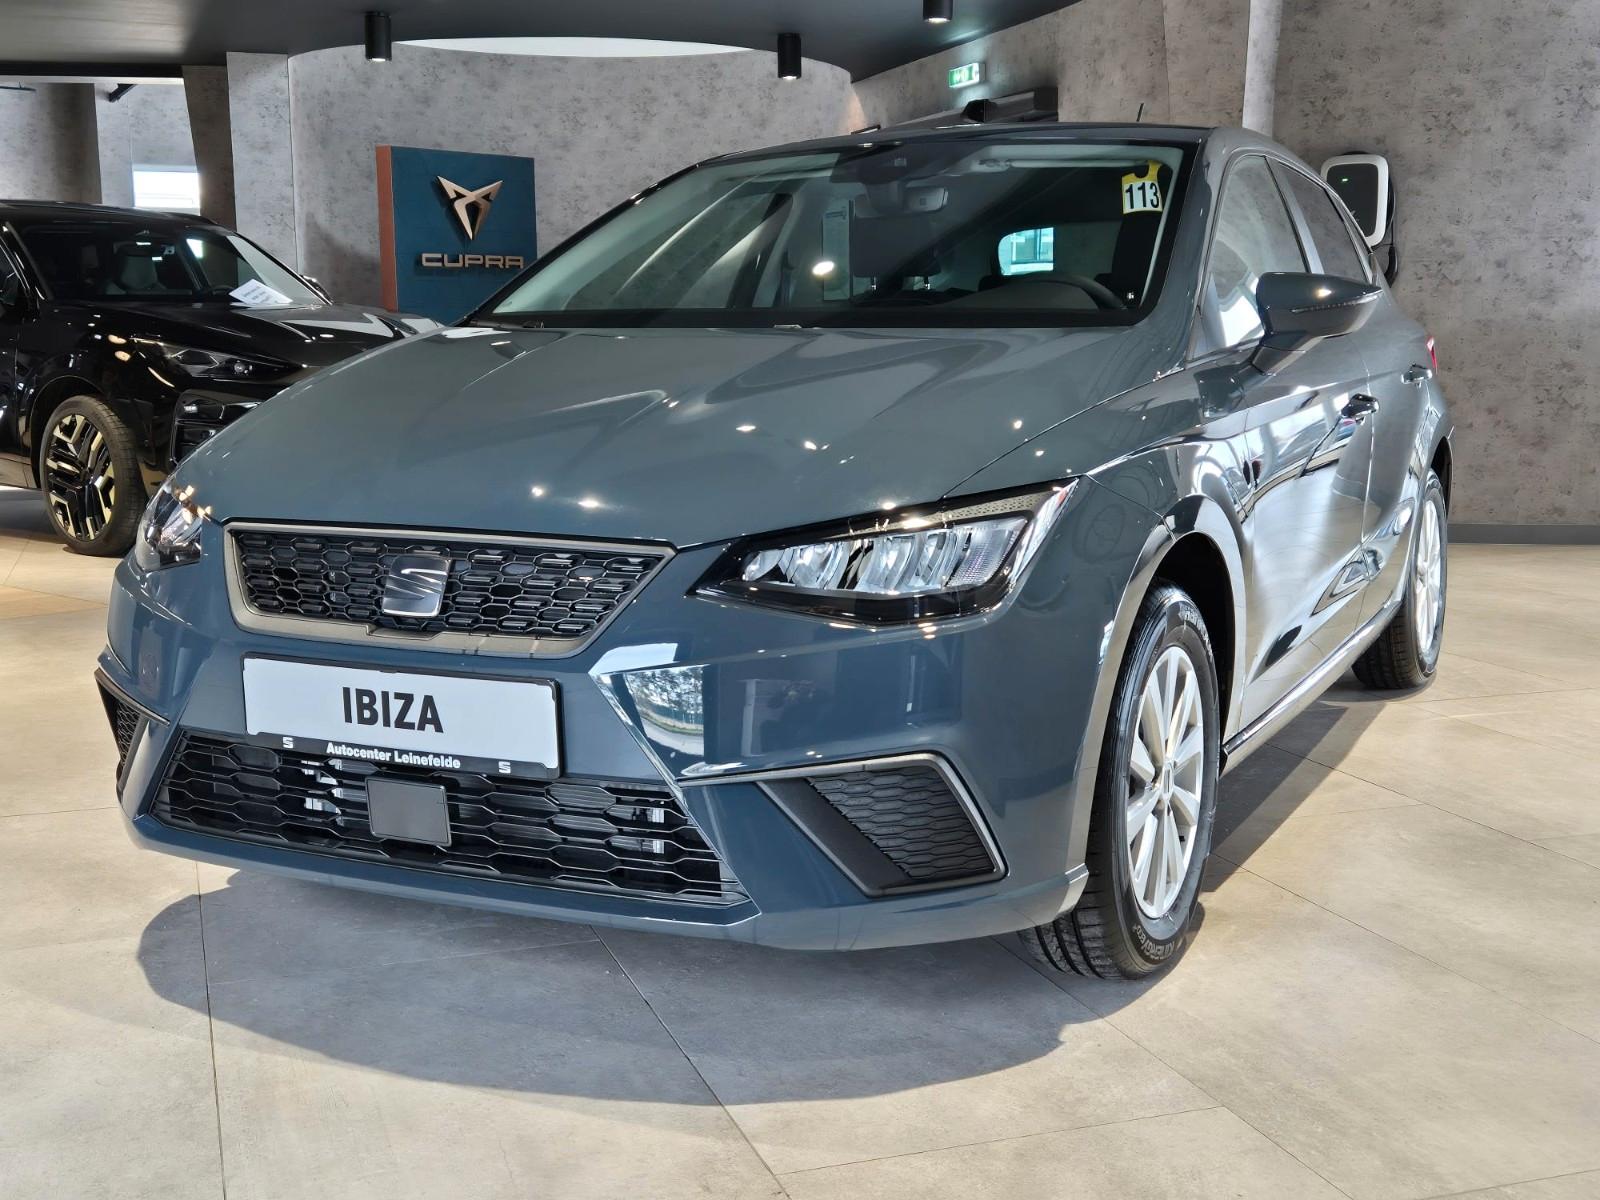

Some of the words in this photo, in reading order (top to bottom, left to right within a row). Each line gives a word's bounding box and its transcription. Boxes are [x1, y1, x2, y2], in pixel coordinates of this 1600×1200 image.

[1125, 182, 1160, 209] 113
[421, 253, 524, 269] CUPRA
[342, 686, 444, 734] IBIZA
[326, 742, 392, 762] Autocenter
[394, 750, 461, 769] Leinefelde
